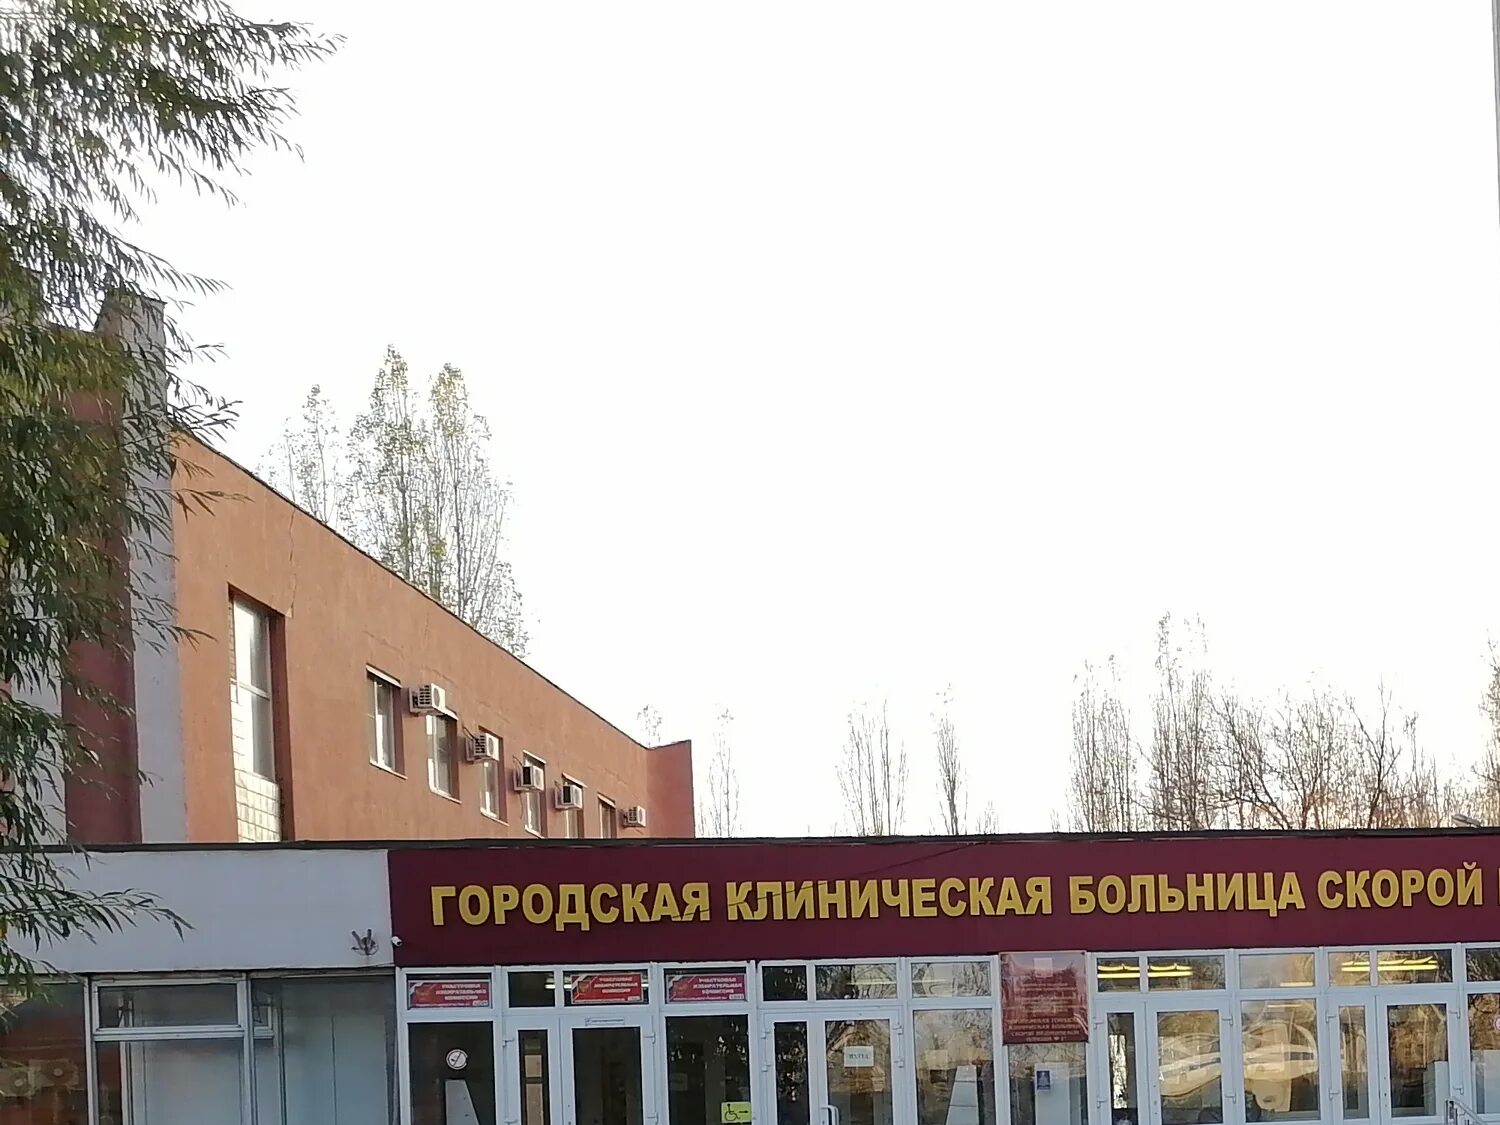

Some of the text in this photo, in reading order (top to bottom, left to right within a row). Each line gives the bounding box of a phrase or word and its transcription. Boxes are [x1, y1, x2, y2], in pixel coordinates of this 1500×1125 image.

[431, 882, 710, 931] ГОРОДСКАЯ
[726, 875, 1052, 921] КЛИНИЧЕСКАЯ
[1069, 872, 1304, 917] БОЛЬНИЦА
[1317, 863, 1483, 909] СКОРОЙ
